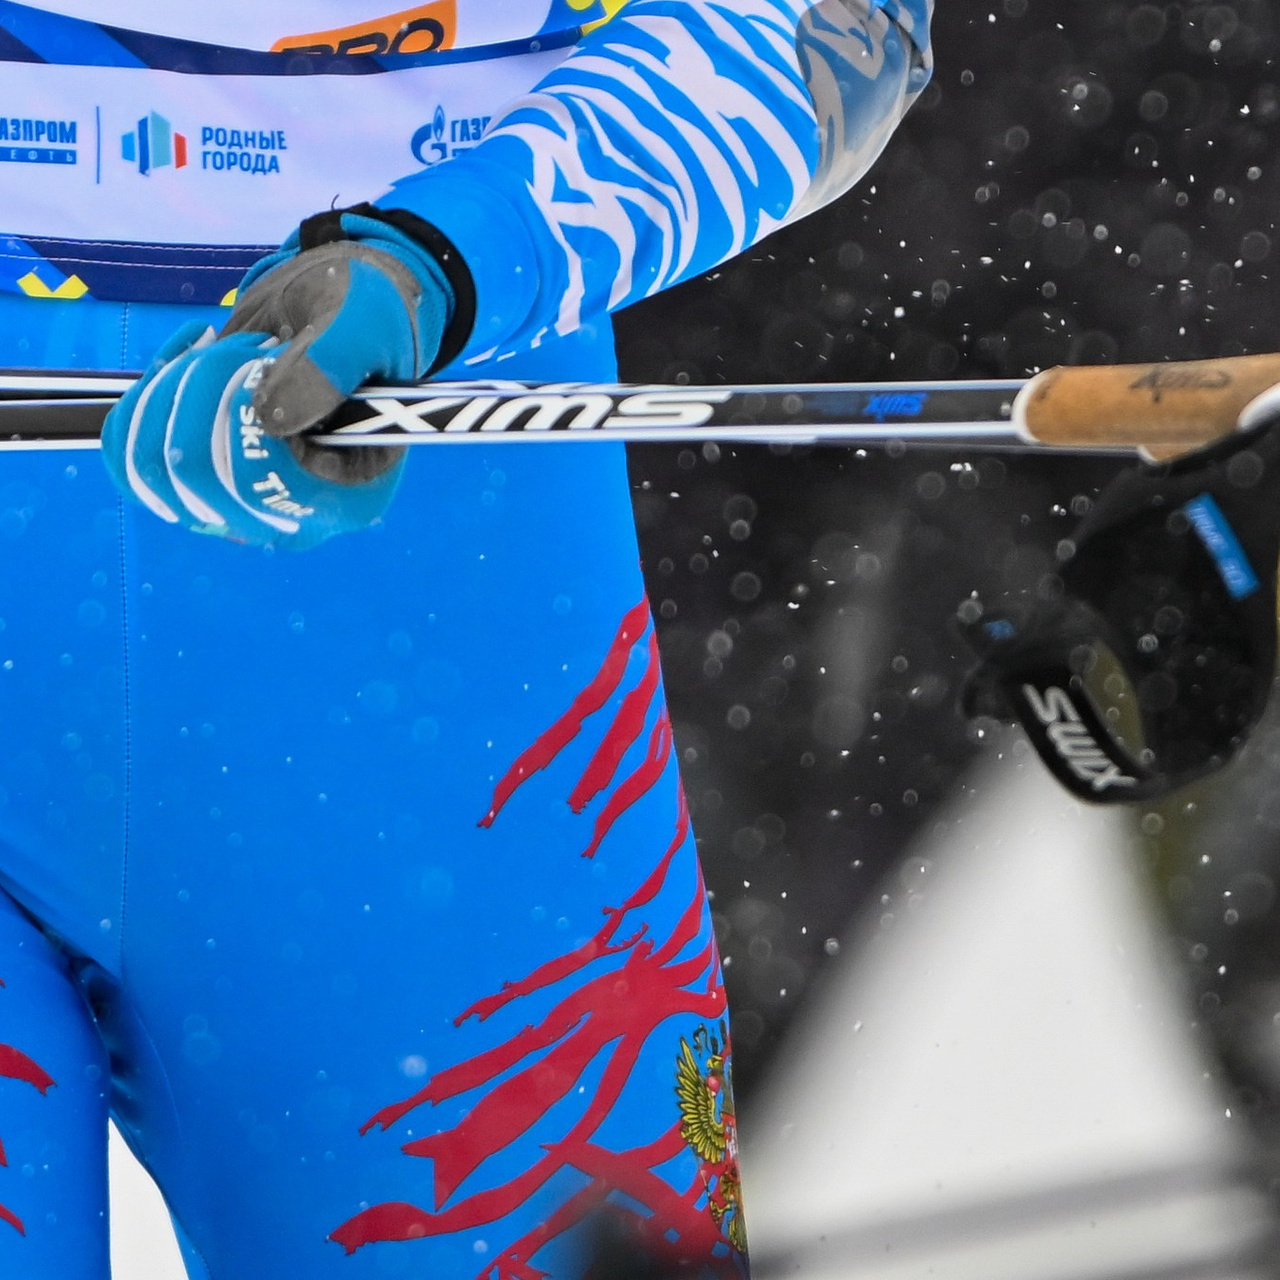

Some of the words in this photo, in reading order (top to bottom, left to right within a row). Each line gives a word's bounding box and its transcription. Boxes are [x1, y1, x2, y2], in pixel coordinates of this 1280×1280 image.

[202, 126, 288, 151] РОДНЫЕ
[202, 150, 280, 176] ГОРОДА
[1022, 683, 1137, 791] SWIX
